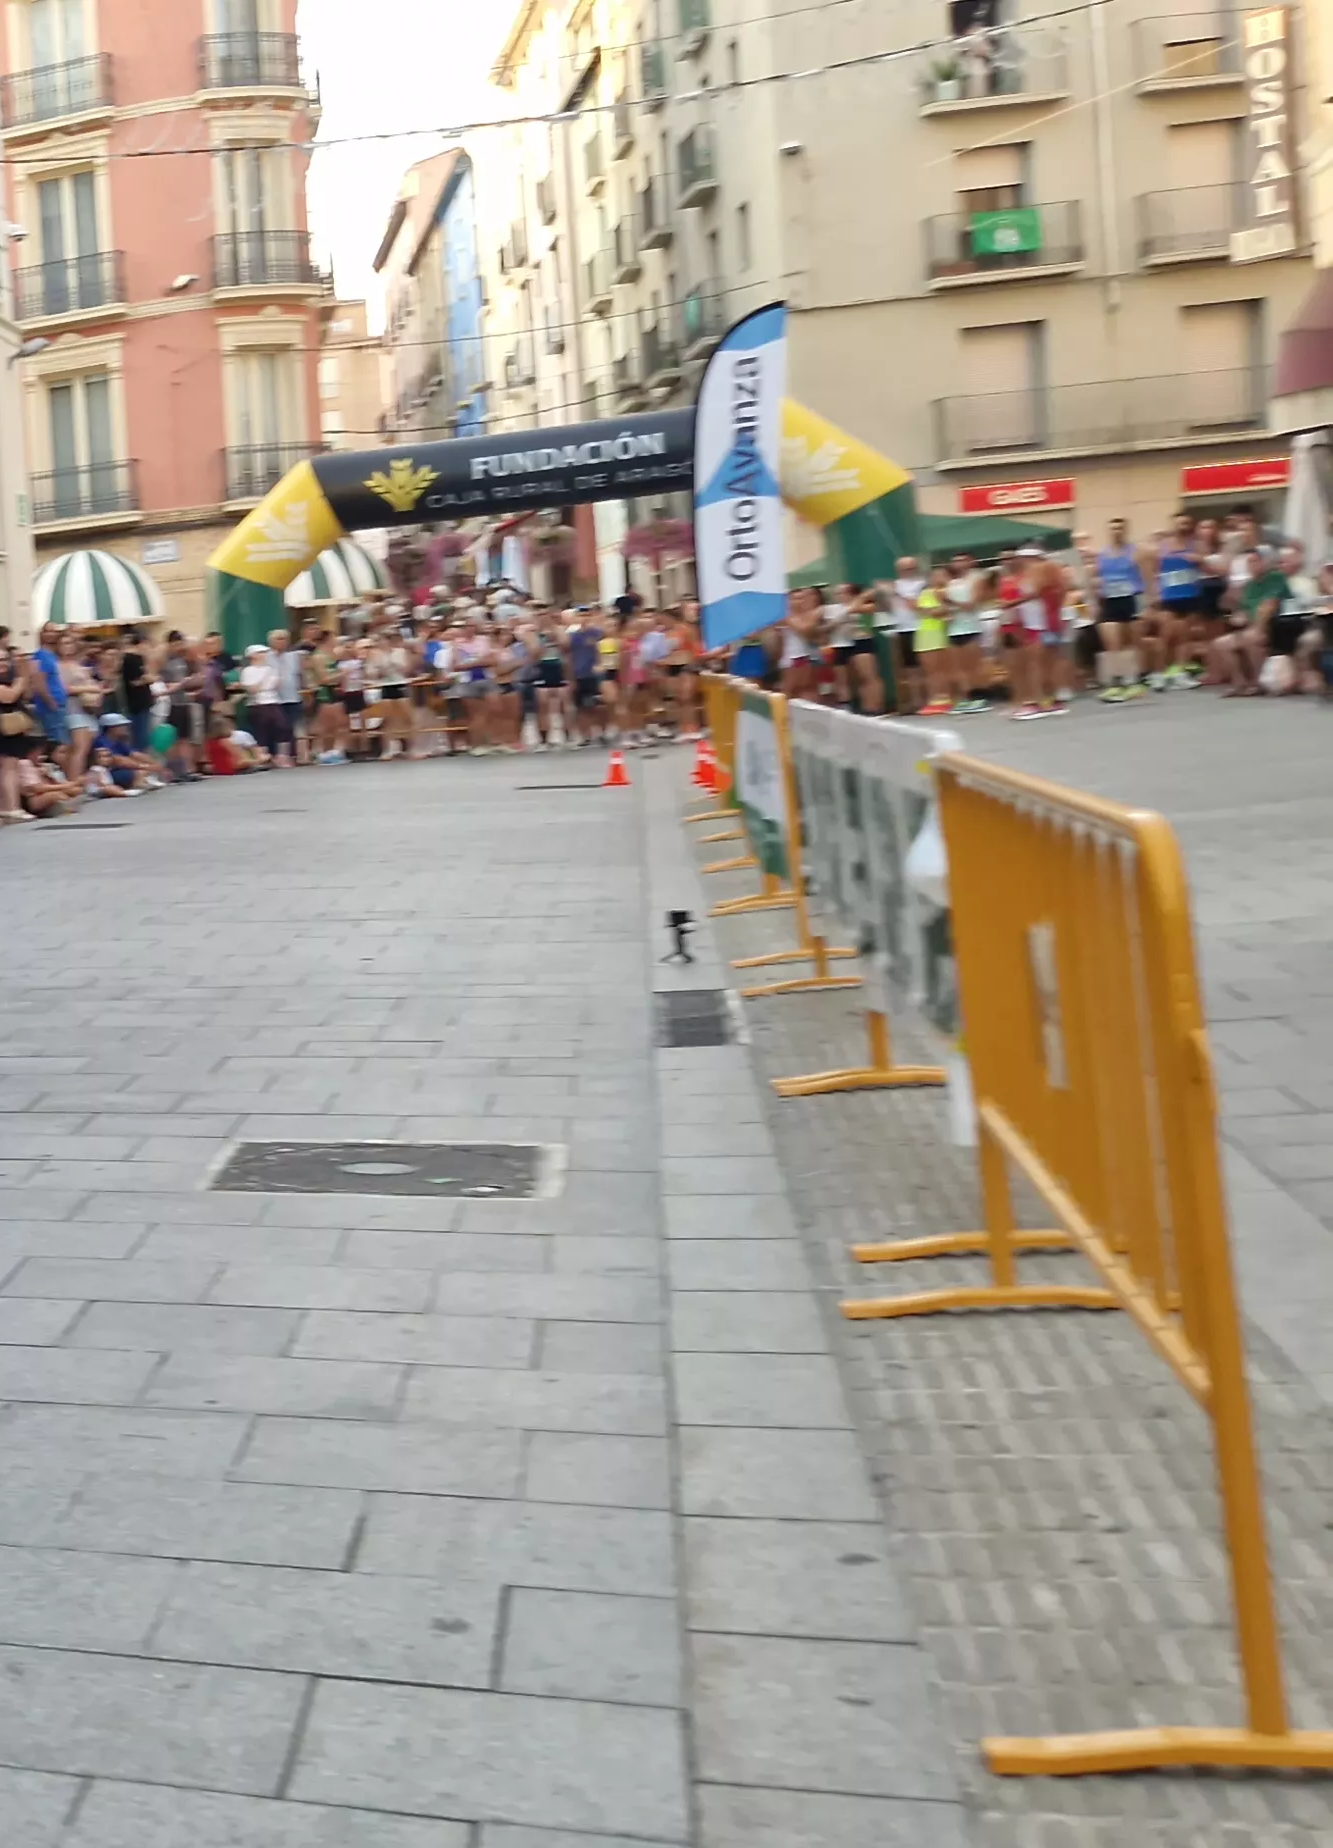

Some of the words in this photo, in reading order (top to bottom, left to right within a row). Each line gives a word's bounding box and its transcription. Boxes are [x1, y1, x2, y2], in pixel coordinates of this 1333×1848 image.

[469, 431, 667, 480] FUNDACIÓN
[724, 355, 761, 582] OrtoAvanza
[425, 490, 486, 508] CAJA
[490, 480, 571, 500] RURAL
[574, 473, 609, 490] DE
